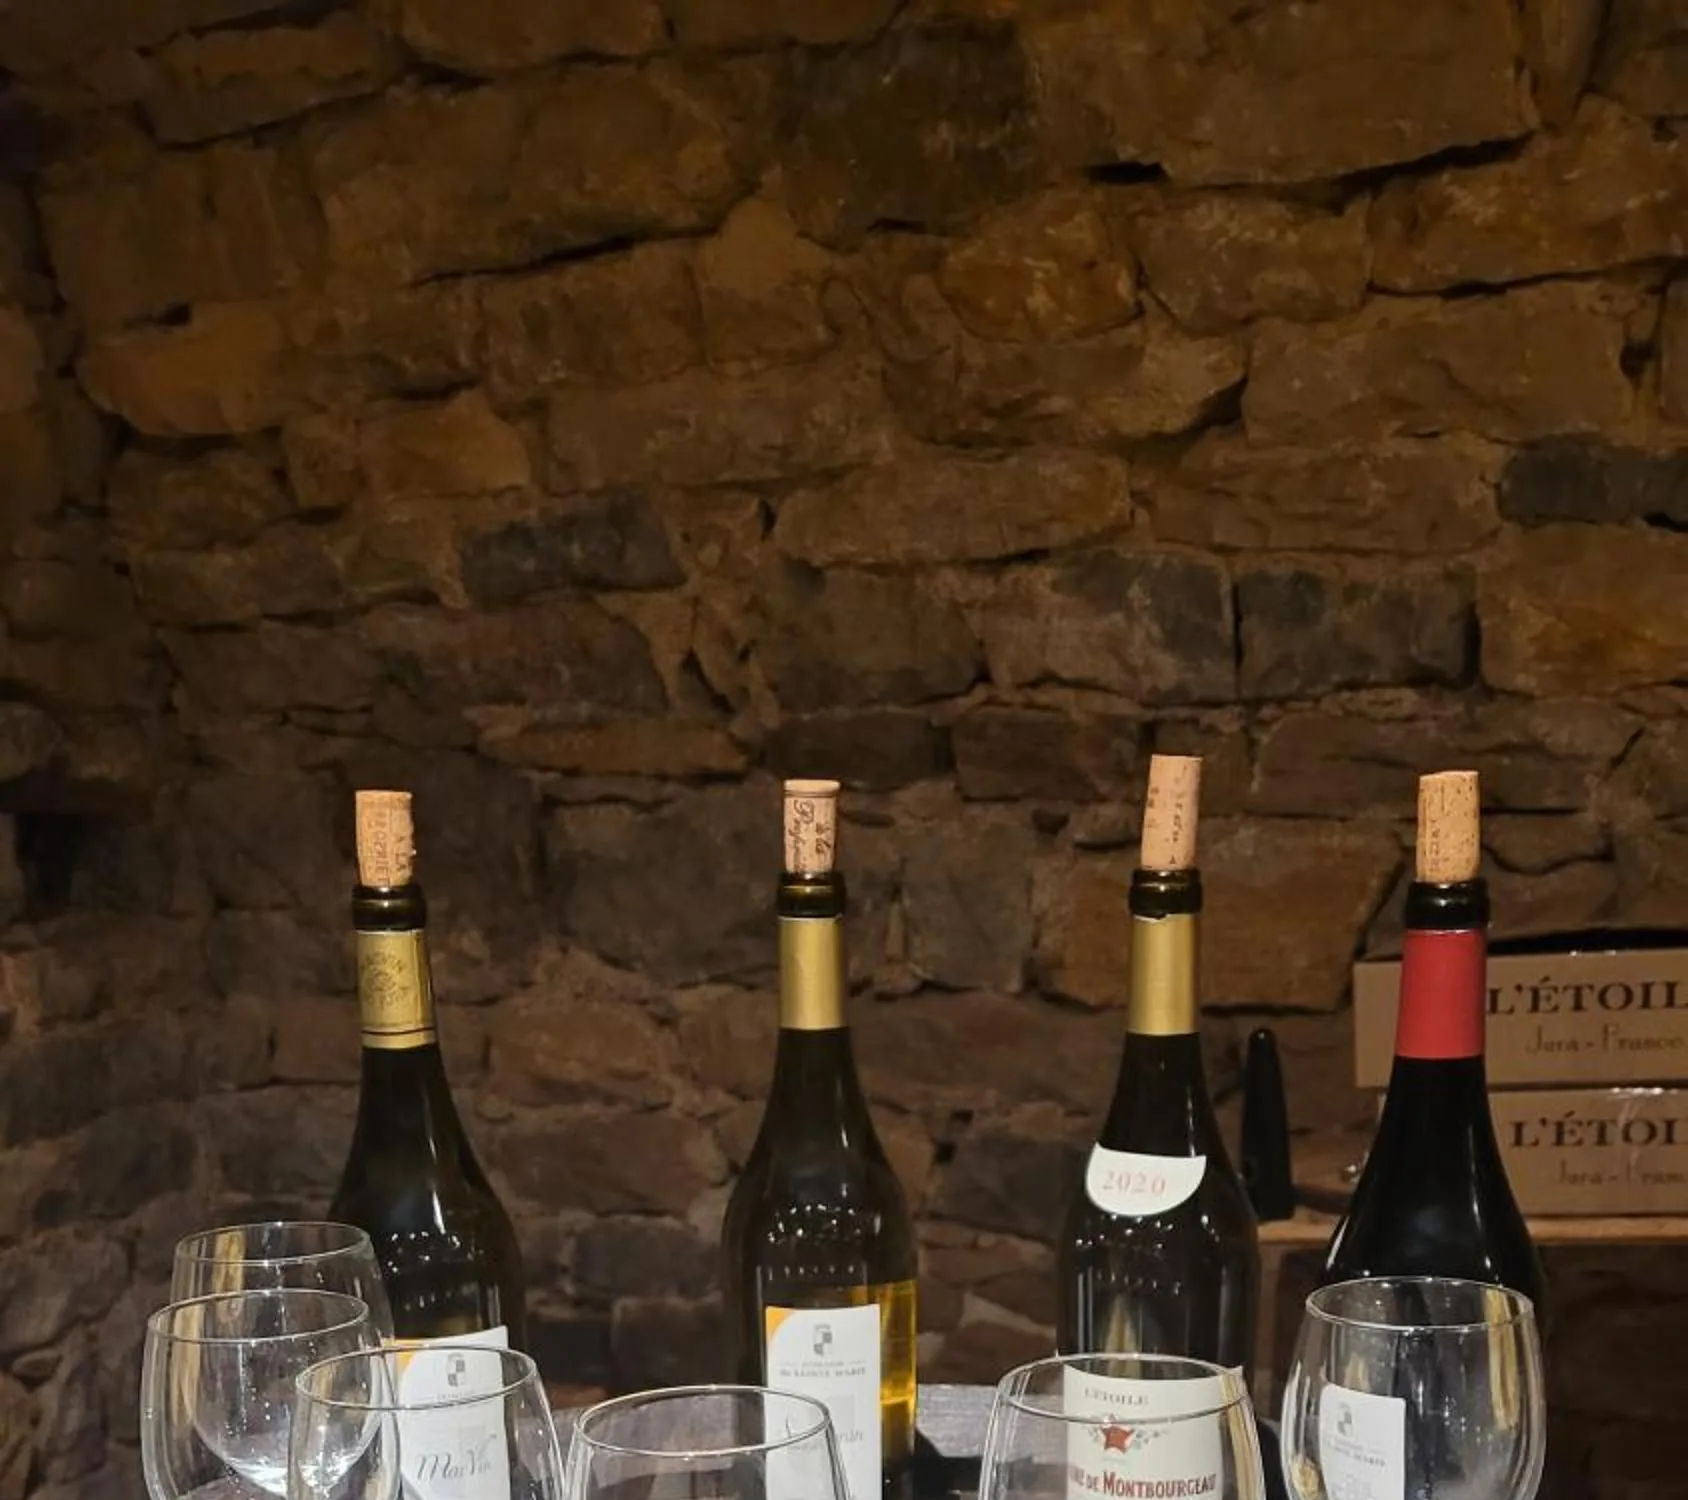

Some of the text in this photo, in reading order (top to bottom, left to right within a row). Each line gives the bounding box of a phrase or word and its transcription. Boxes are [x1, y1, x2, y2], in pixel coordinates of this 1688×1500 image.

[1526, 1024, 1580, 1054] Jura
[1602, 1022, 1685, 1052] France
[1509, 1111, 1688, 1148] L'ÉTOI
[1103, 1171, 1166, 1196] 2020
[1626, 1160, 1688, 1185] Fran
